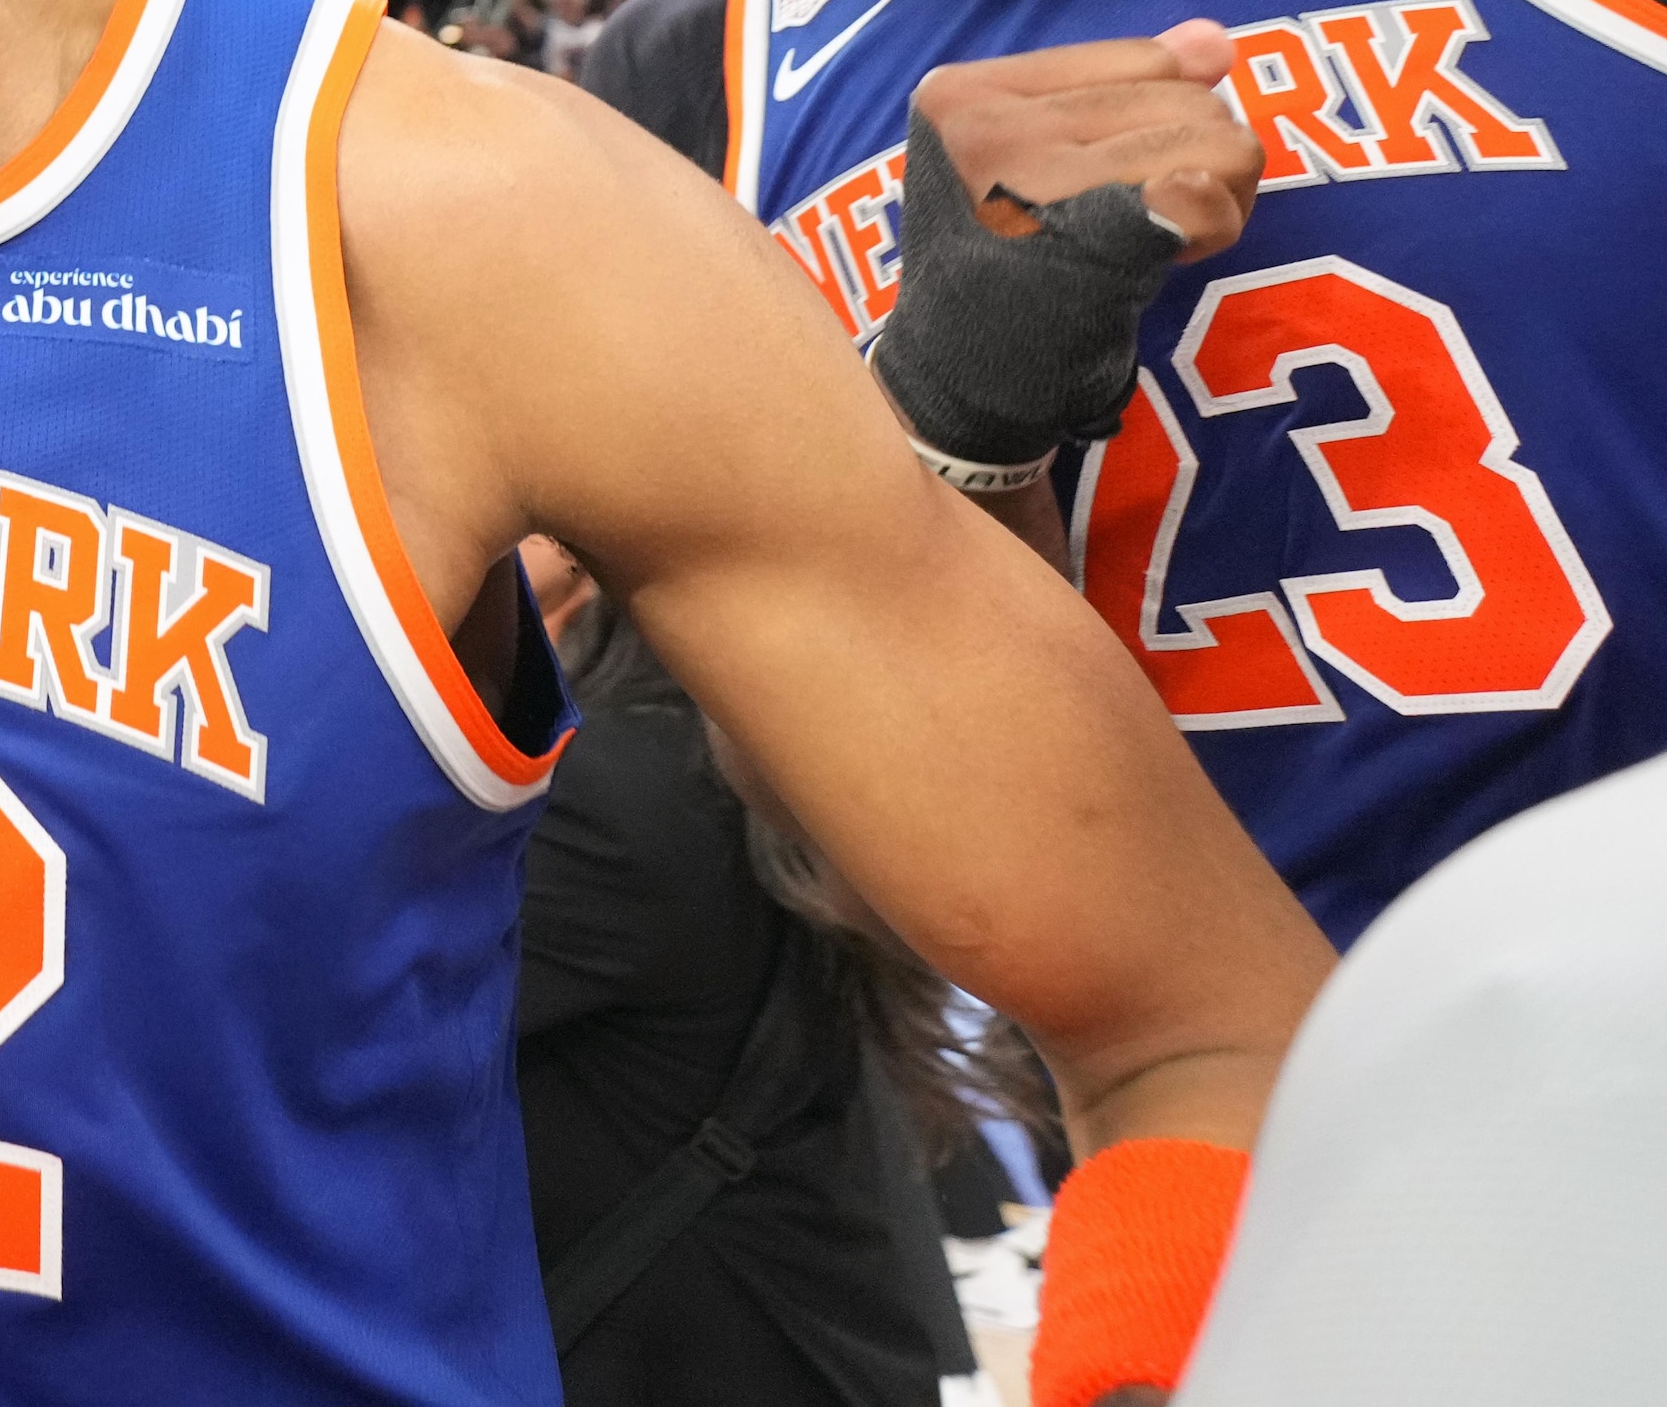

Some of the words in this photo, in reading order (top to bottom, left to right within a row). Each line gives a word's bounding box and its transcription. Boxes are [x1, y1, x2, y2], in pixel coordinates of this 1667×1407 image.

[10, 268, 133, 289] experience
[768, 139, 909, 348] NE
[2, 288, 92, 327] abu
[101, 292, 243, 349] dhabi
[1069, 255, 1613, 731] 23
